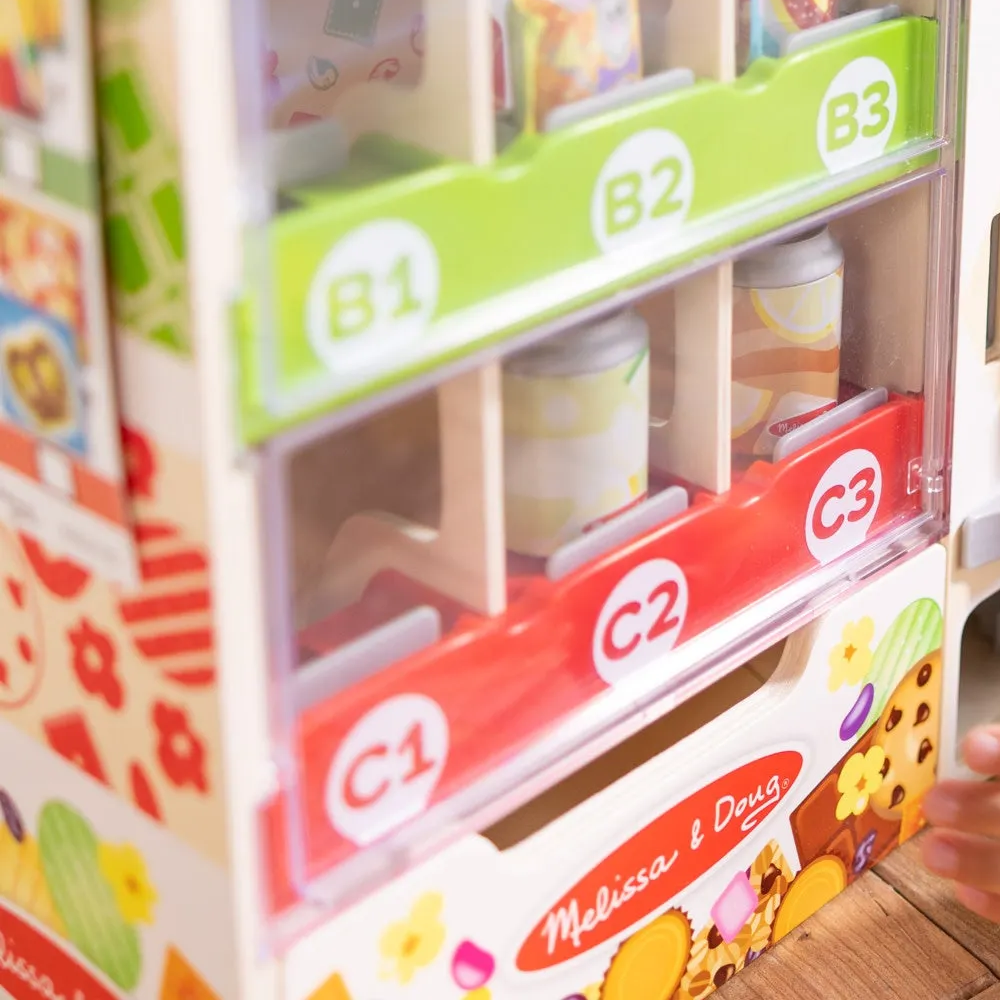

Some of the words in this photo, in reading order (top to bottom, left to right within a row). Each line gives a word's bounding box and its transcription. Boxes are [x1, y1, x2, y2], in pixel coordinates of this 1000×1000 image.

[325, 252, 423, 340] B1
[602, 155, 685, 236] B2
[825, 80, 890, 153] B3
[341, 720, 434, 810] C1
[602, 578, 680, 662] C2
[810, 466, 877, 540] C3
[541, 849, 679, 955] Melissa
[689, 817, 705, 851] &
